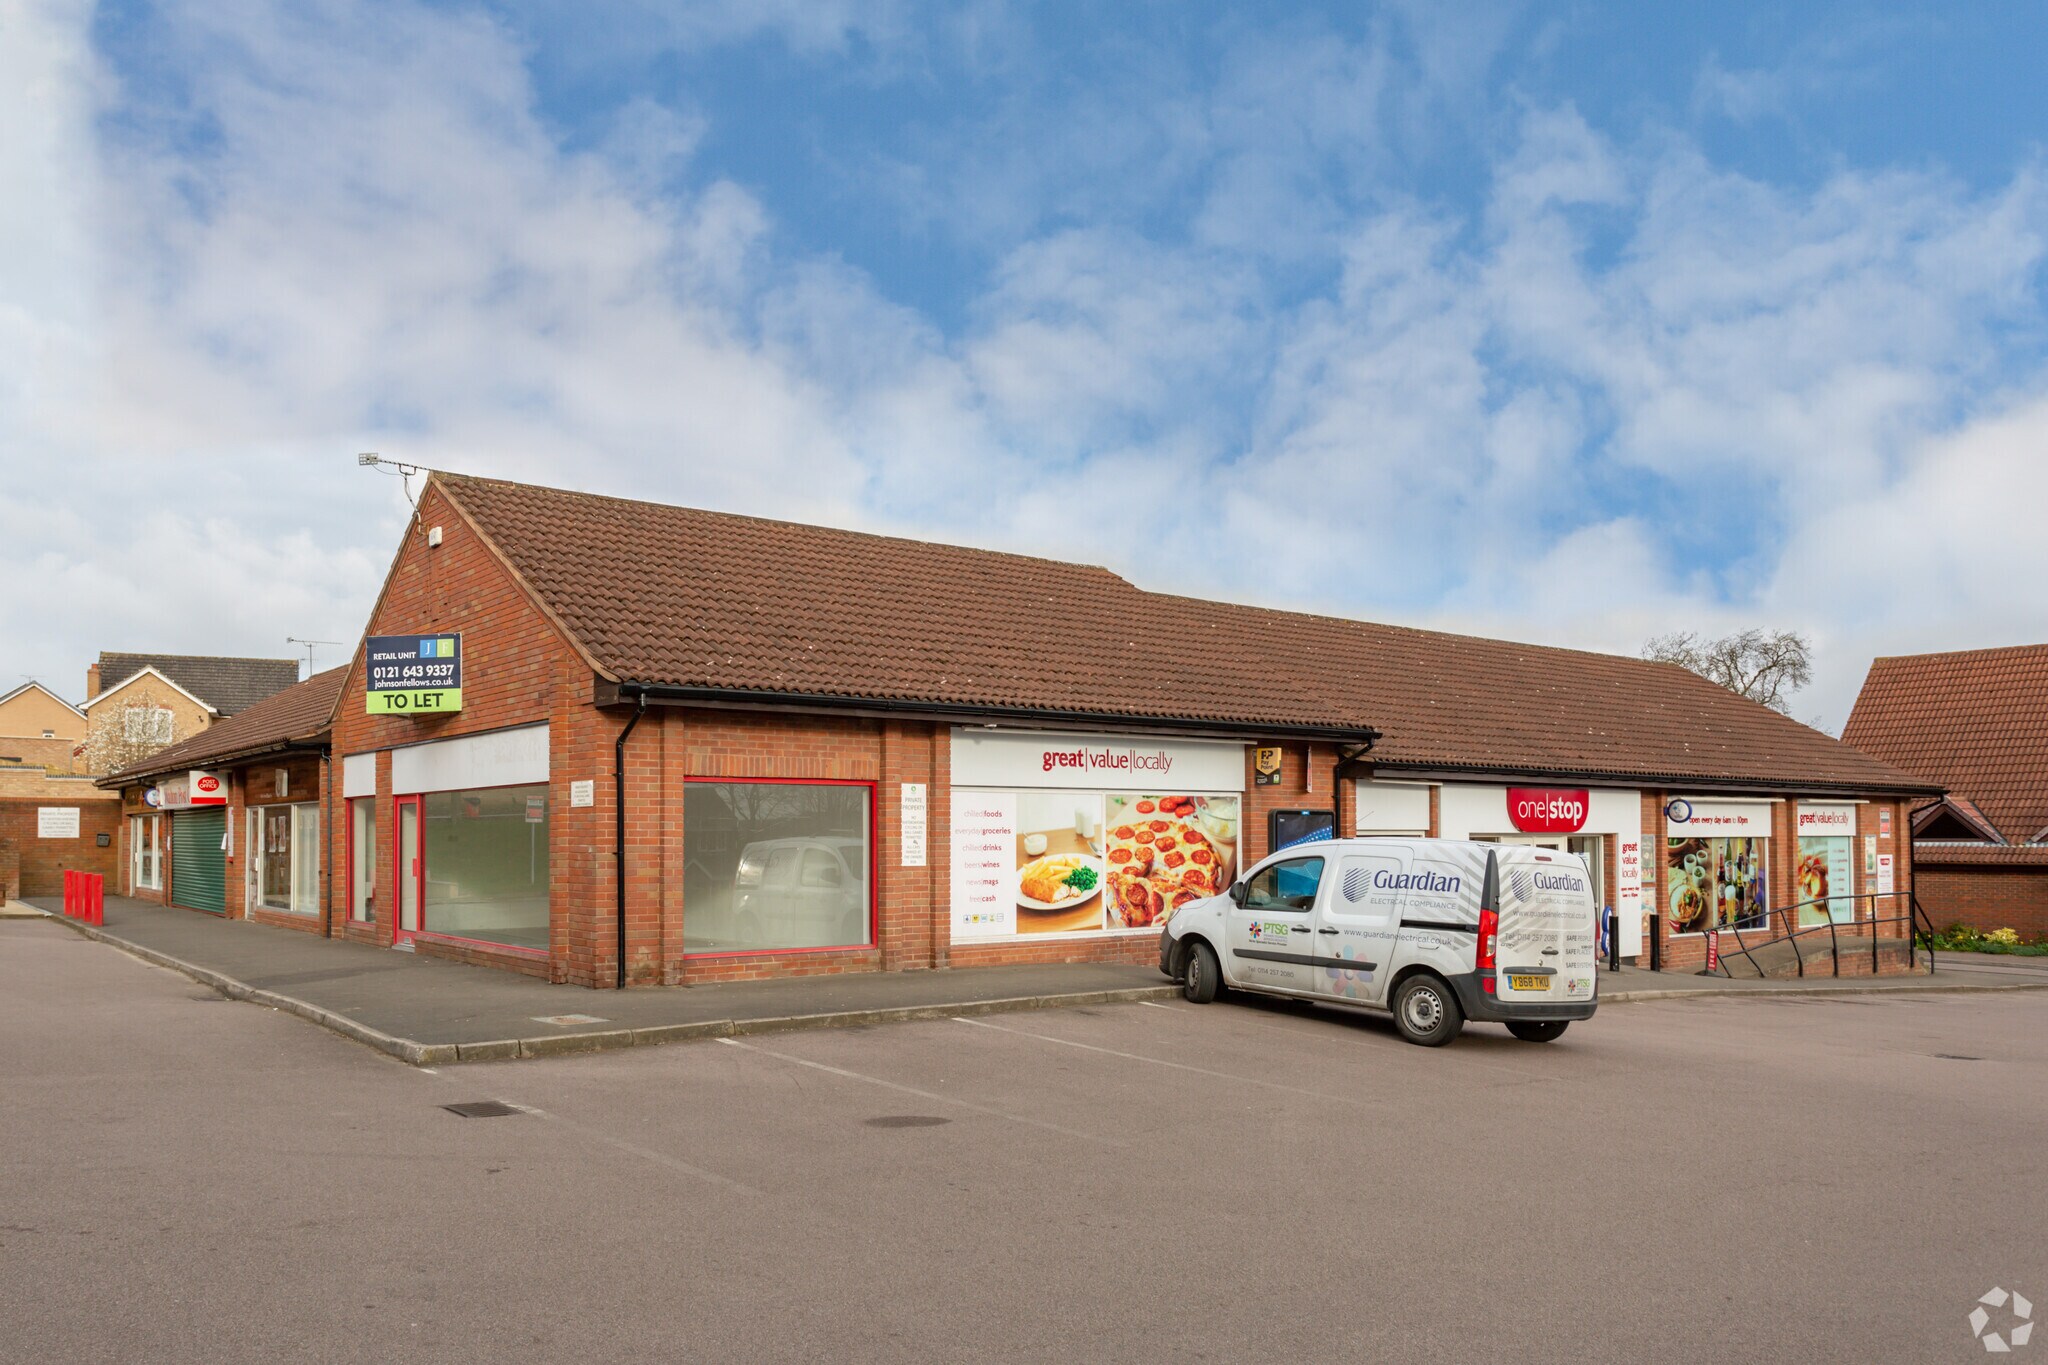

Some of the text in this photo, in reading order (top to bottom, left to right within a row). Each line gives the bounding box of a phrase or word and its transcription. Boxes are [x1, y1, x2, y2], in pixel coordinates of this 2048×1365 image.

[373, 652, 397, 660] RETAIL
[373, 664, 454, 678] 0121 643 9337
[374, 677, 454, 690] johnsonfellows.co.uk
[383, 693, 444, 708] TO LET
[1042, 748, 1173, 774] great value locally
[984, 810, 1002, 818] foods
[1518, 796, 1583, 826] one stop
[1689, 817, 1700, 825] open
[1701, 817, 1712, 825] every
[1800, 812, 1849, 826] great value locally
[982, 827, 1011, 836] groceries
[1622, 842, 1638, 854] great
[1622, 854, 1638, 864] value
[1622, 868, 1638, 879] locally
[1373, 869, 1461, 893] Guardian
[1534, 872, 1584, 892] Guardian
[1370, 898, 1456, 910] ELECTRICAL COMPLIANCE
[1263, 922, 1288, 935] PTSG
[1343, 928, 1452, 945] www.guardianelectrical.co.uk
[1535, 976, 1549, 987] TKU
[1576, 979, 1590, 987] PTSG
